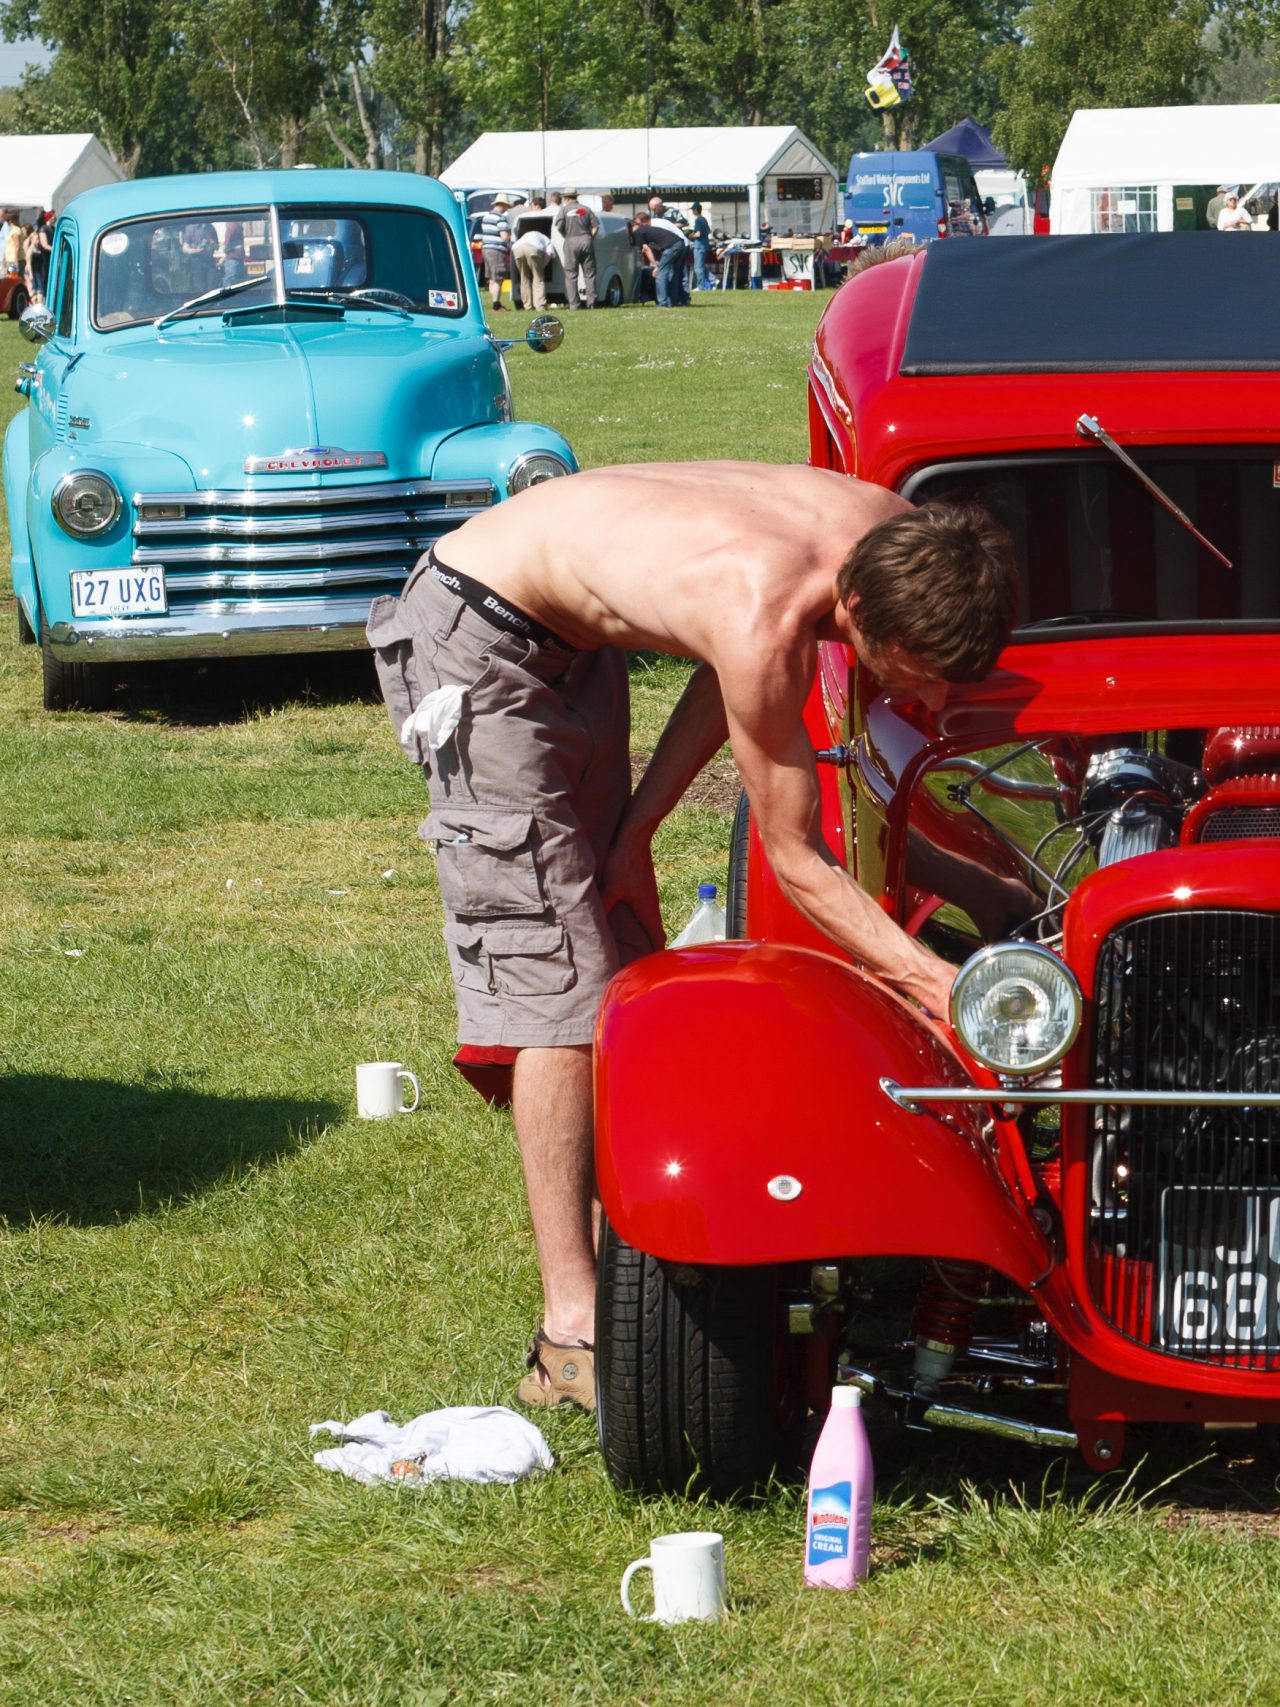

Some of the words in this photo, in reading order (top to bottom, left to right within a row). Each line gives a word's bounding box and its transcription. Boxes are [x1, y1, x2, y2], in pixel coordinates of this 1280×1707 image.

[883, 183, 904, 207] SVC
[267, 457, 362, 470] CHEVROLET
[76, 580, 109, 606] 127
[119, 577, 161, 604] UXG
[813, 1533, 842, 1545] ORIGINAL
[812, 1541, 843, 1553] CREAM
